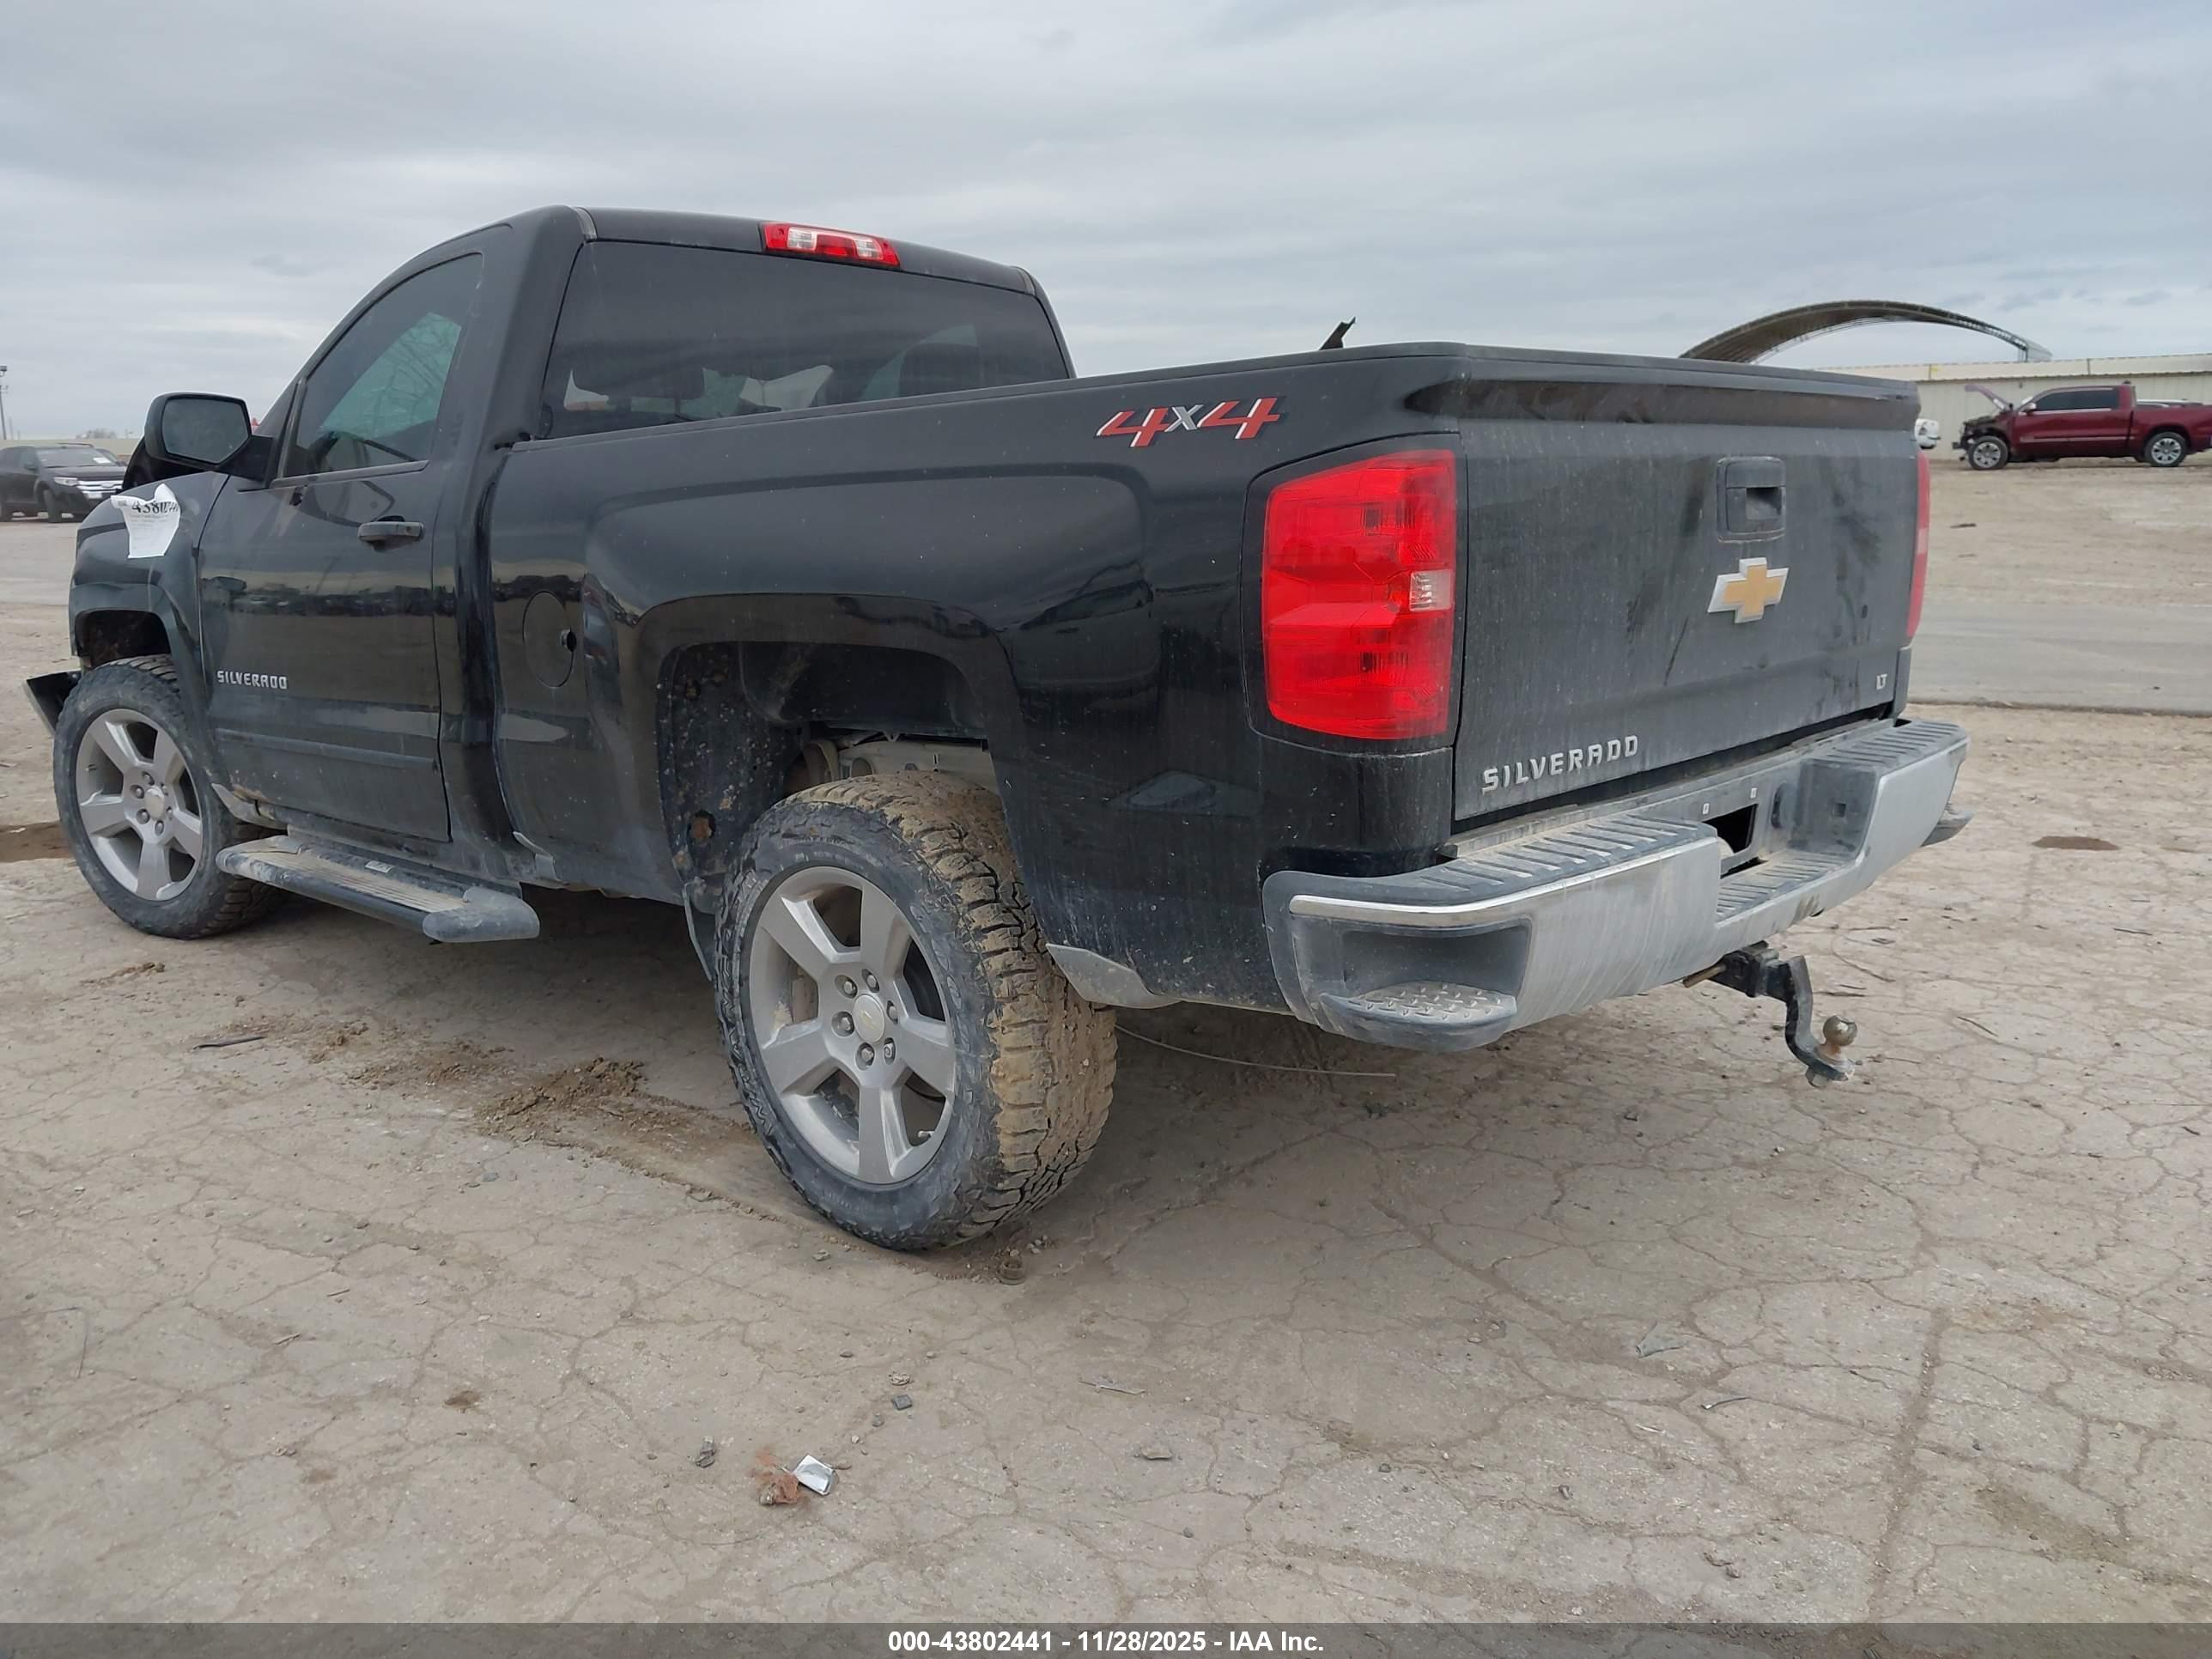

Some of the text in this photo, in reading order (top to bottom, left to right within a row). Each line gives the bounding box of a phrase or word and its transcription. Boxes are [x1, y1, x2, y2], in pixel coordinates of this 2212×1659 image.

[216, 670, 288, 690] SILVERADO
[1876, 673, 1888, 690] LT
[1481, 734, 1638, 795] SILVERADO
